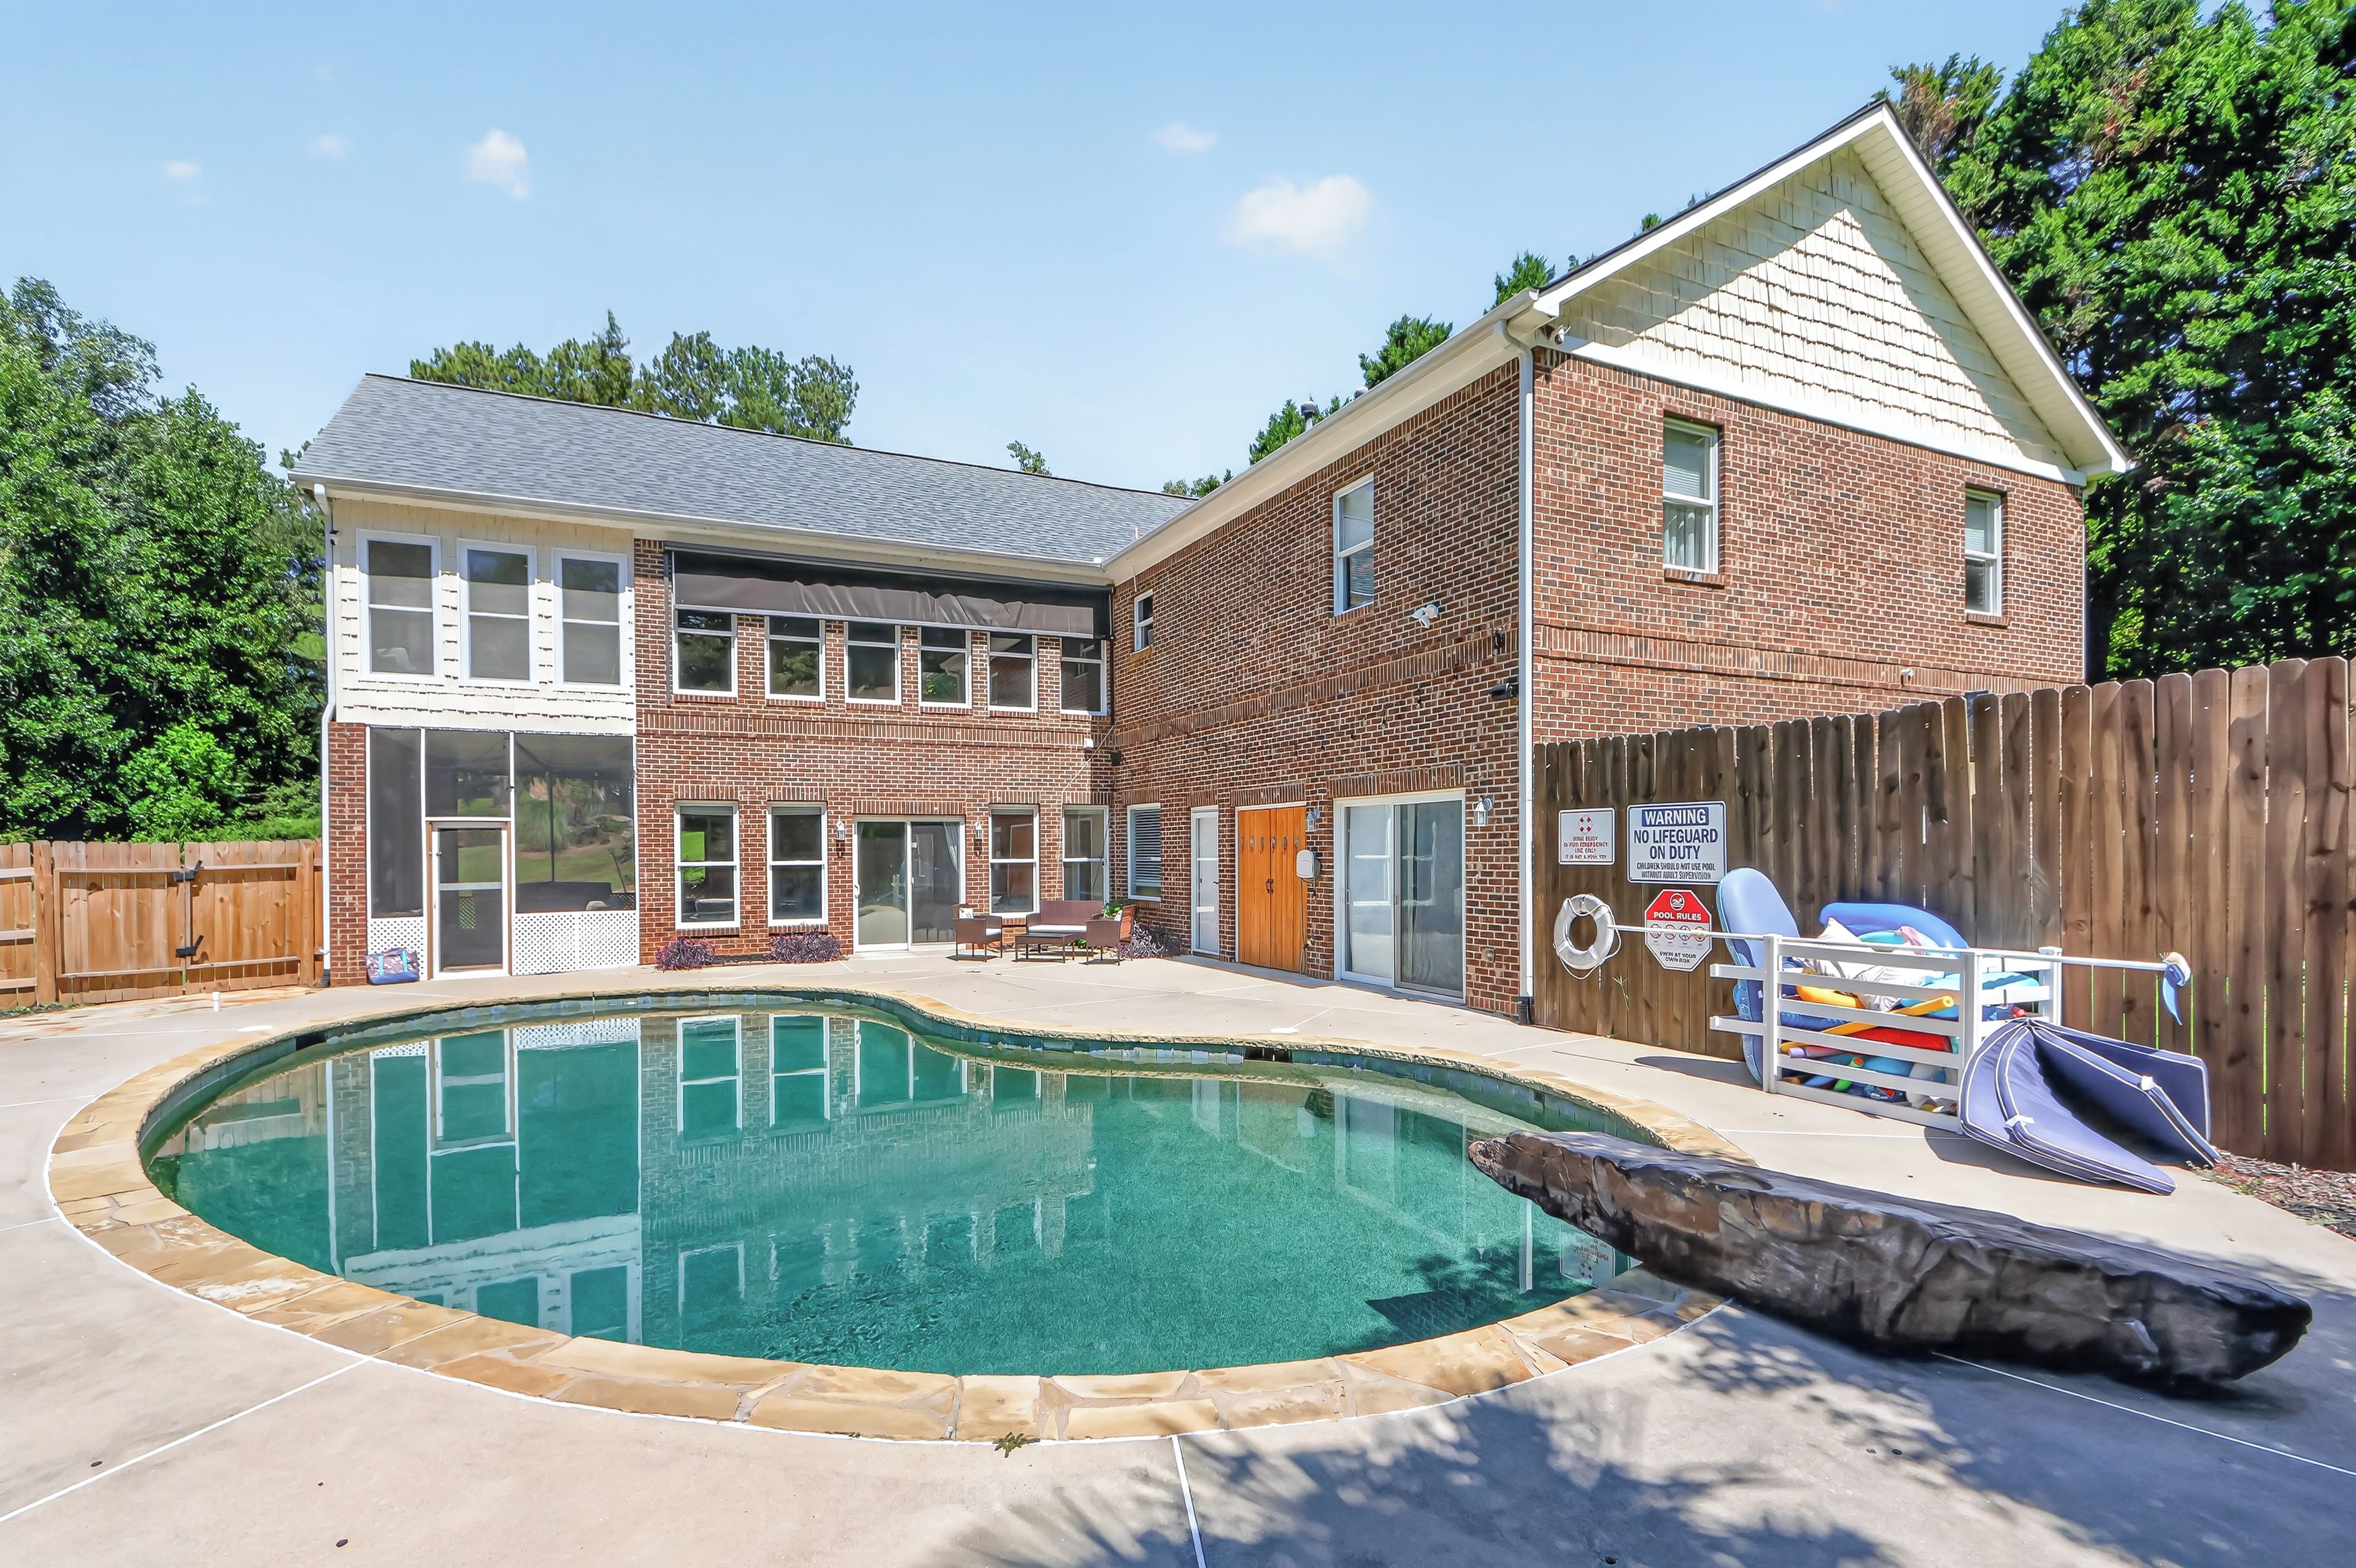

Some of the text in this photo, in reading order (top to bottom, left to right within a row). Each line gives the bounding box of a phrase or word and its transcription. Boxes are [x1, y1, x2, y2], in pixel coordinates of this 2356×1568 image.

[1645, 809, 1706, 825] WARNING
[1634, 828, 1718, 844] NO LIFEGUARD
[1650, 845, 1700, 859] ON DUTY
